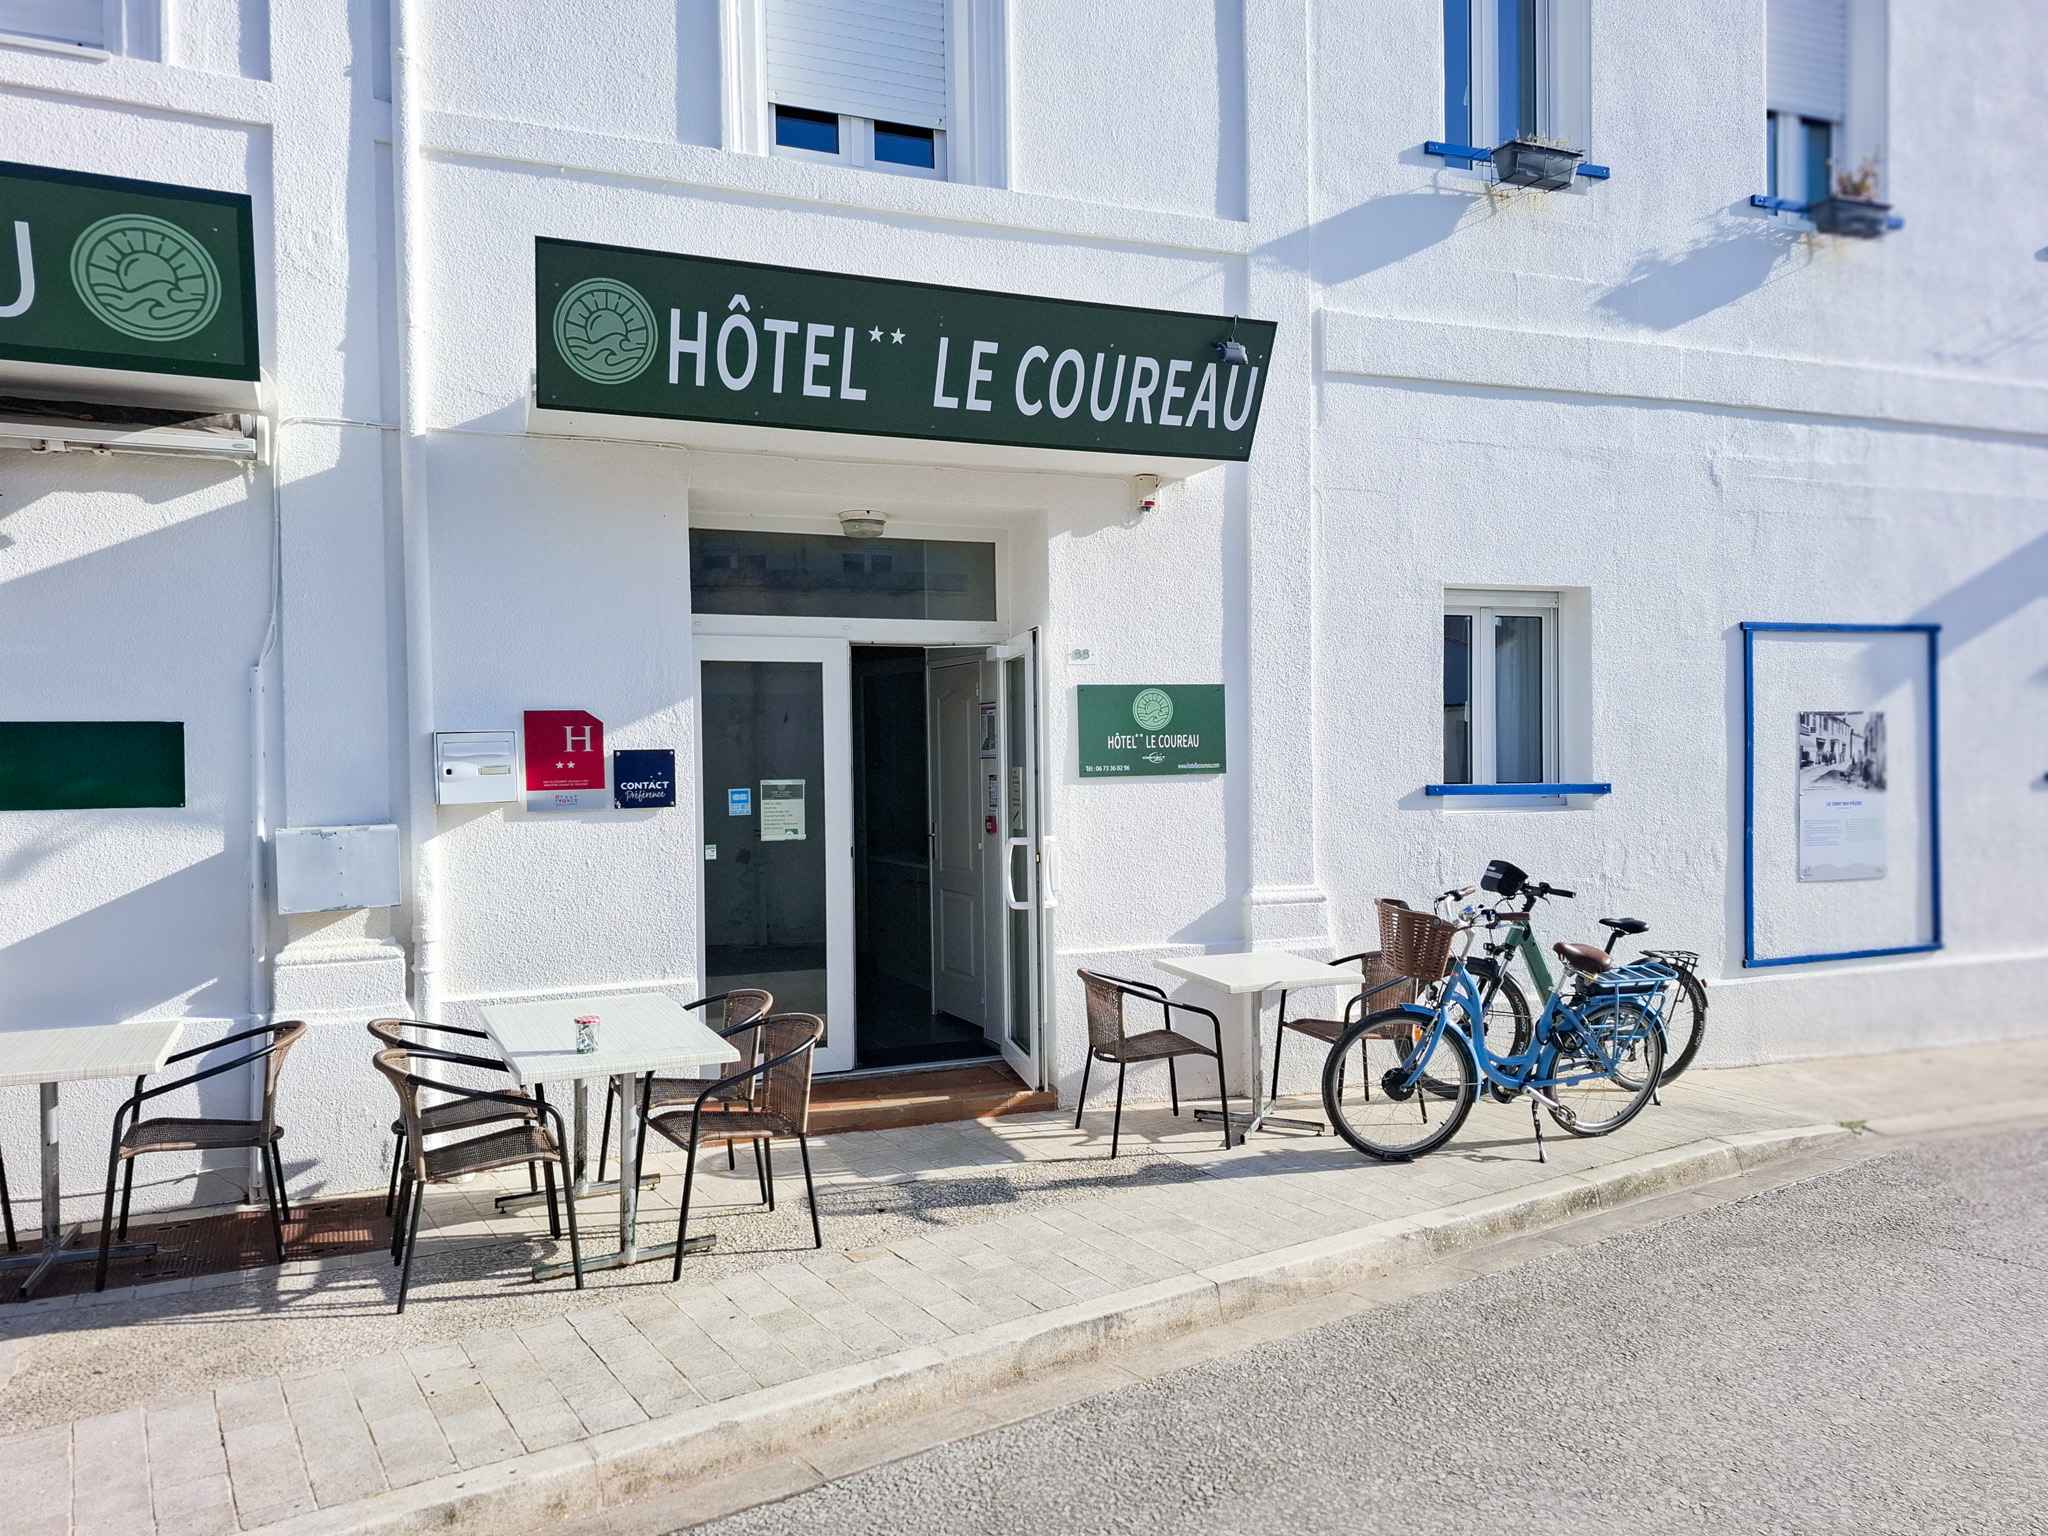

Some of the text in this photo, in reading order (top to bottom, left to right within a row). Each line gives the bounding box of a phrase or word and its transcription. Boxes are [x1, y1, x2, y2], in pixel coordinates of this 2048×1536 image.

[669, 293, 1259, 432] HÔTEL LE COUREAU
[563, 725, 594, 752] H
[1107, 732, 1199, 749] HÔTEL LE COUREAU
[620, 781, 669, 790] CONTACT
